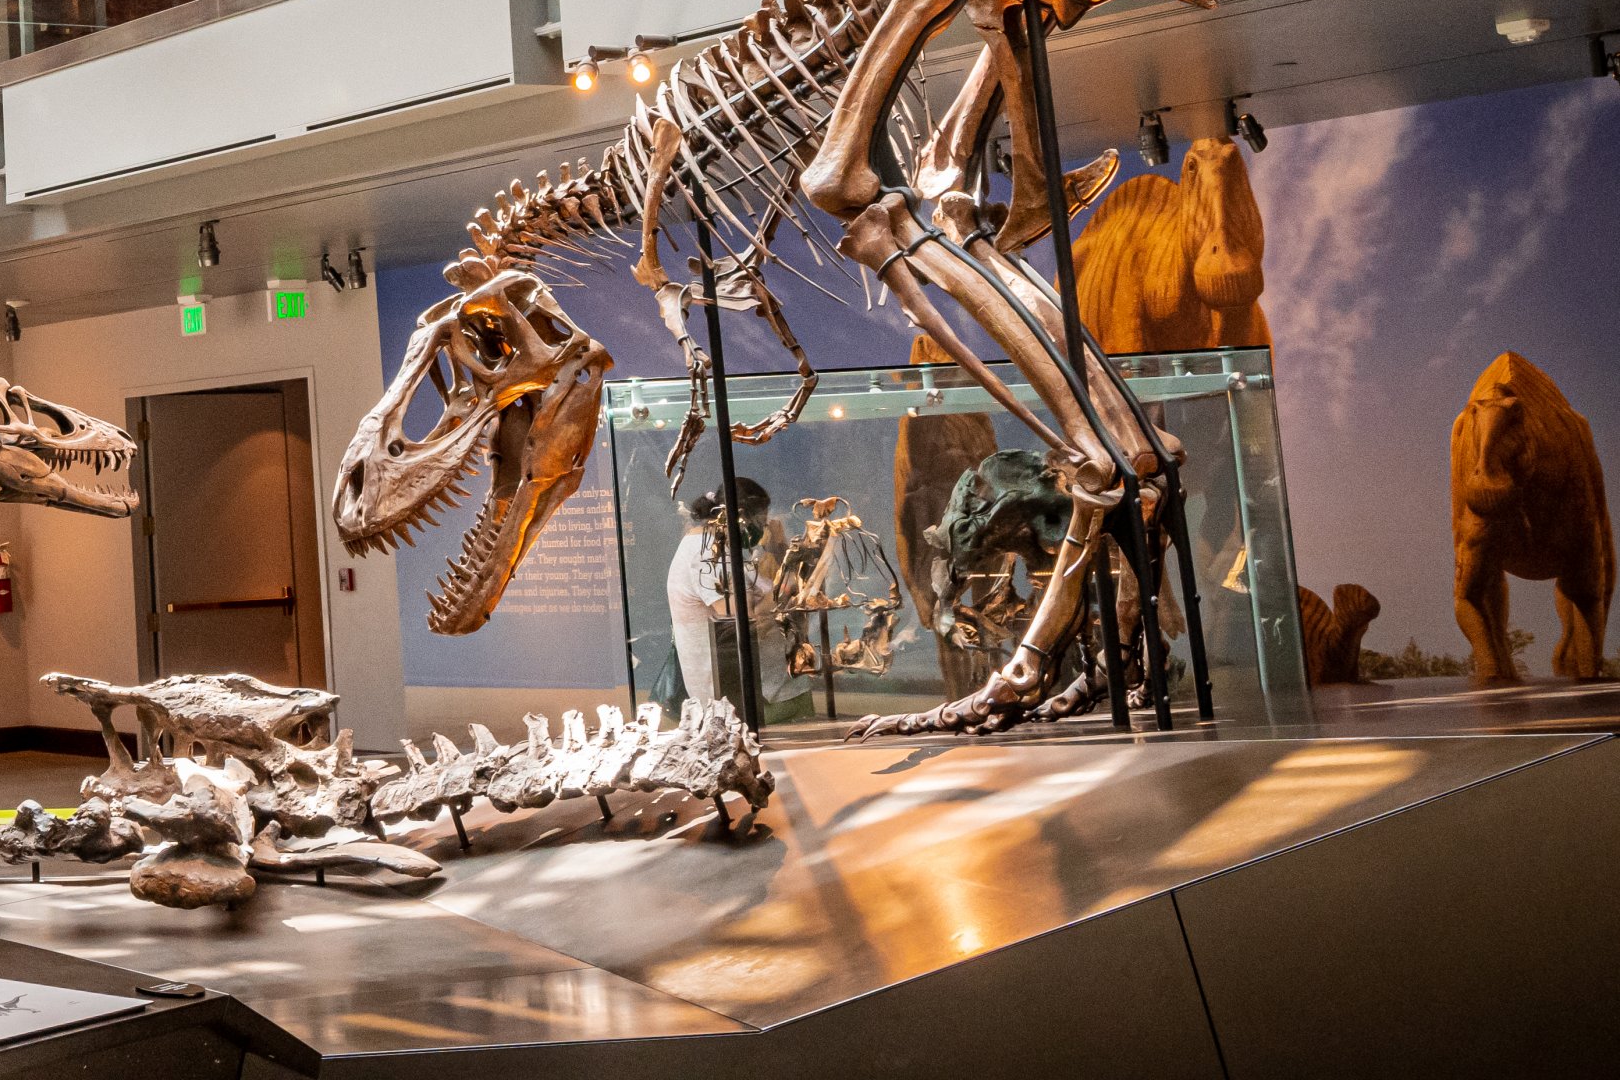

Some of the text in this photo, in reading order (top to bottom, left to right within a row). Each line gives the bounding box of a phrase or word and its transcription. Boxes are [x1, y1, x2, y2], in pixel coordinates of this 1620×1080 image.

[276, 291, 305, 319] EXIT
[183, 306, 203, 335] EXIT
[582, 485, 599, 500] only
[562, 503, 584, 515] bones
[559, 522, 567, 532] to
[541, 536, 568, 548] hunted
[570, 536, 581, 548] for
[583, 535, 601, 548] food
[537, 553, 557, 566] They
[559, 553, 585, 565] sought
[525, 569, 542, 581] their
[545, 572, 570, 583] young.
[572, 569, 592, 582] They
[524, 587, 537, 596] and
[539, 586, 570, 599] injuries.
[571, 585, 591, 598] They
[533, 604, 547, 615] just
[549, 605, 557, 613] as
[559, 605, 570, 613] we
[571, 602, 581, 613] do
